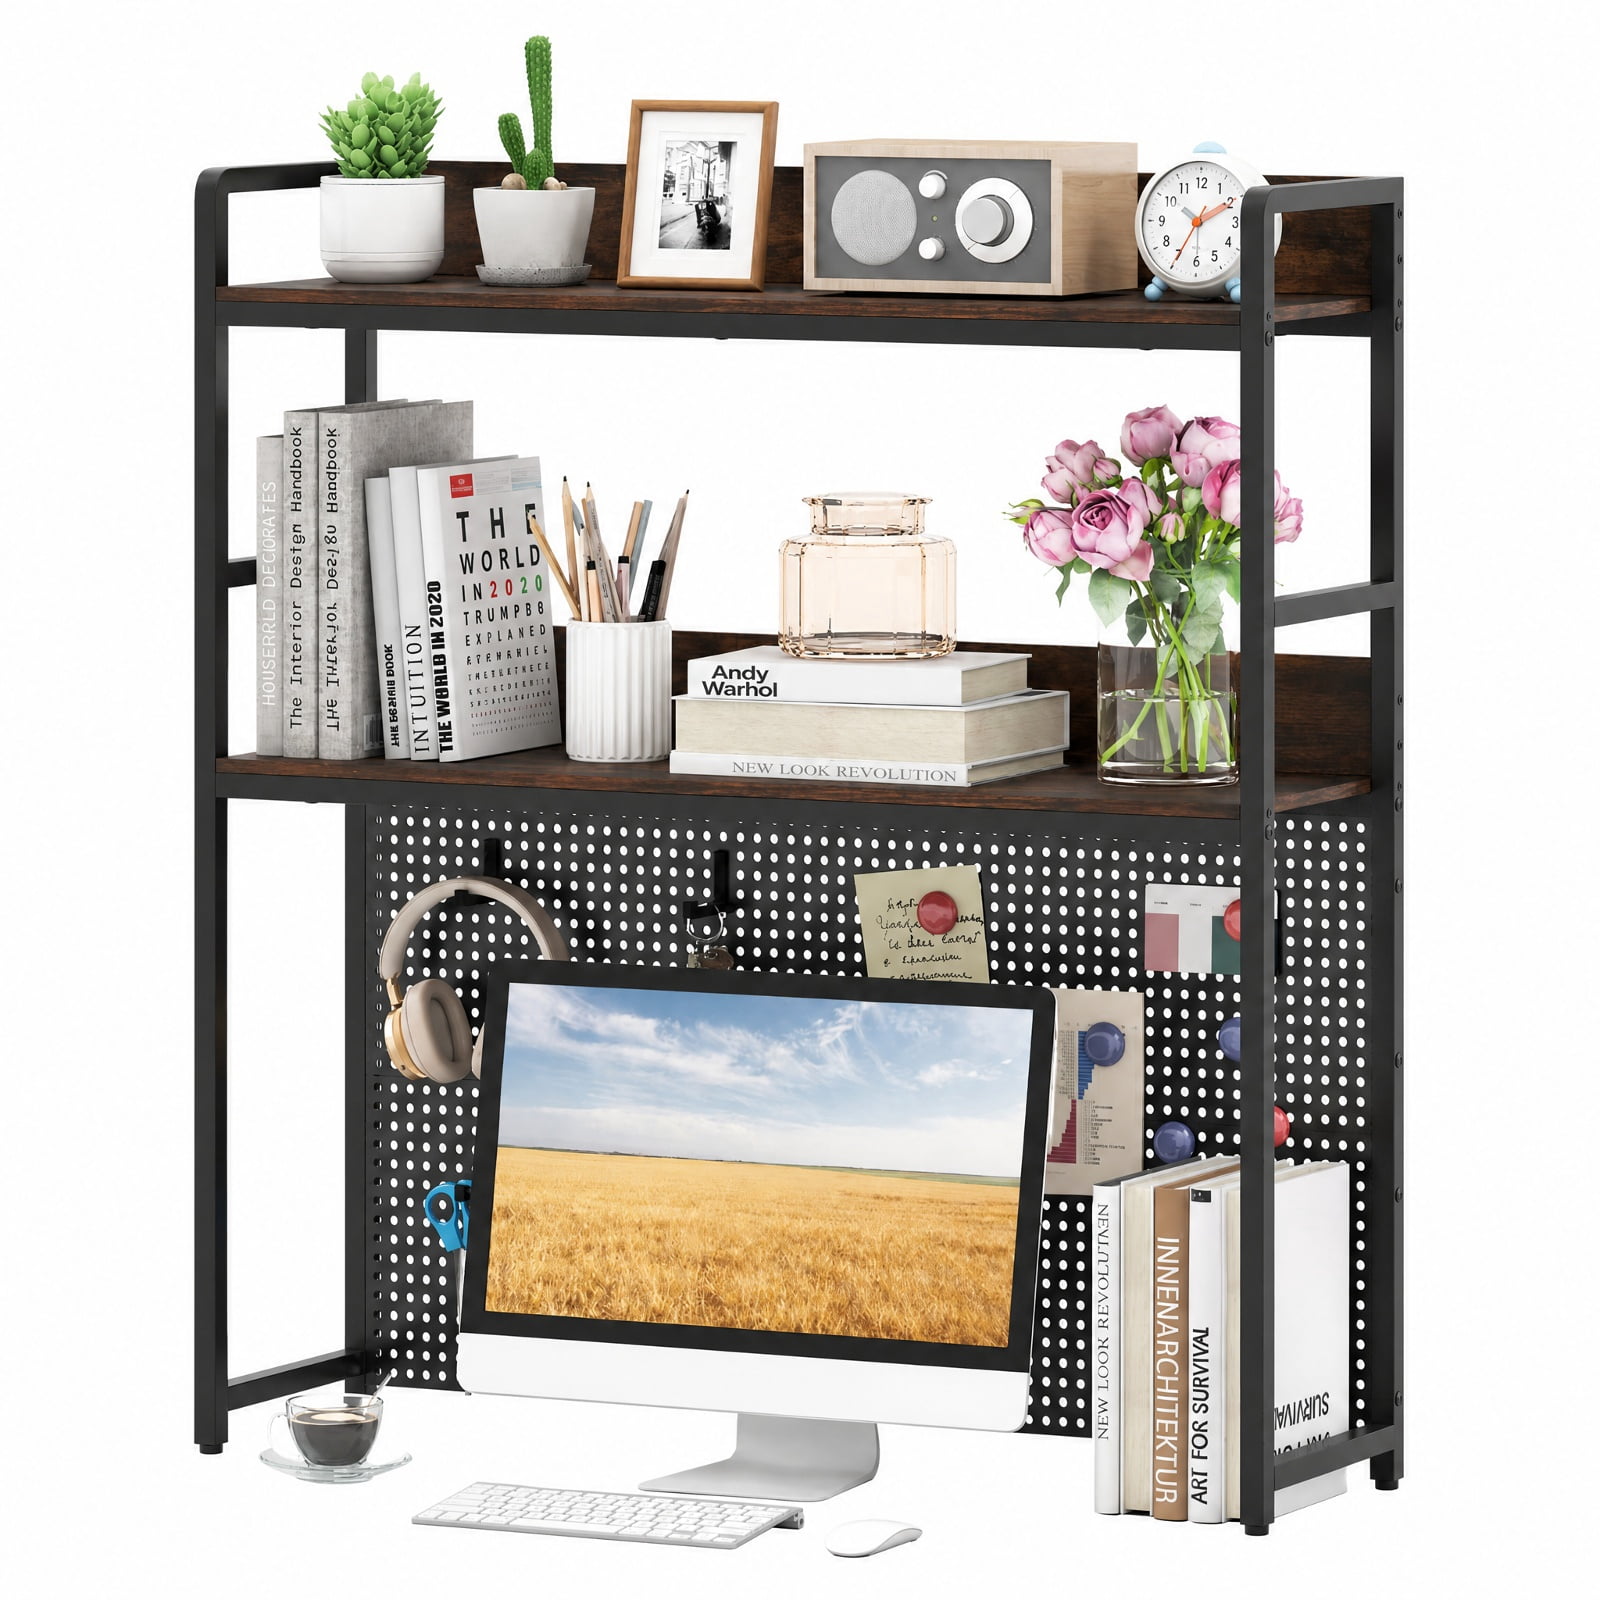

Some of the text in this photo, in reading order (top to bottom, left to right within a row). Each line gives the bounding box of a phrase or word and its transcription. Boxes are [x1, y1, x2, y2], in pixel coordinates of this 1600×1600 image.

[1179, 183, 1189, 194] 11
[1196, 177, 1208, 188] 12
[1165, 196, 1177, 207] 10
[1227, 197, 1234, 209] 2
[1159, 215, 1166, 226] 9
[1232, 216, 1239, 228] 3
[1163, 235, 1170, 247] 8
[1225, 236, 1232, 248] 4
[1193, 255, 1200, 267] 6
[1211, 250, 1218, 262] 5
[289, 427, 302, 512] Handbook
[456, 503, 536, 542] THE
[459, 544, 540, 575] WORLD
[461, 574, 542, 602] IN 2020
[427, 580, 443, 628] 2020
[289, 601, 303, 685] Interior
[711, 665, 769, 684] Andy
[405, 624, 429, 753] INTUITION
[702, 681, 778, 697] Warhol
[289, 697, 303, 728] The
[437, 720, 453, 753] THE
[732, 761, 957, 783] NEW LOOK REVOLUTION
[1097, 1336, 1109, 1391] LOOK
[1156, 1237, 1180, 1504] INNENARCHITEKTUR
[1097, 1397, 1109, 1440] NEW
[1191, 1327, 1209, 1505] ART FOR SURVIVAL
